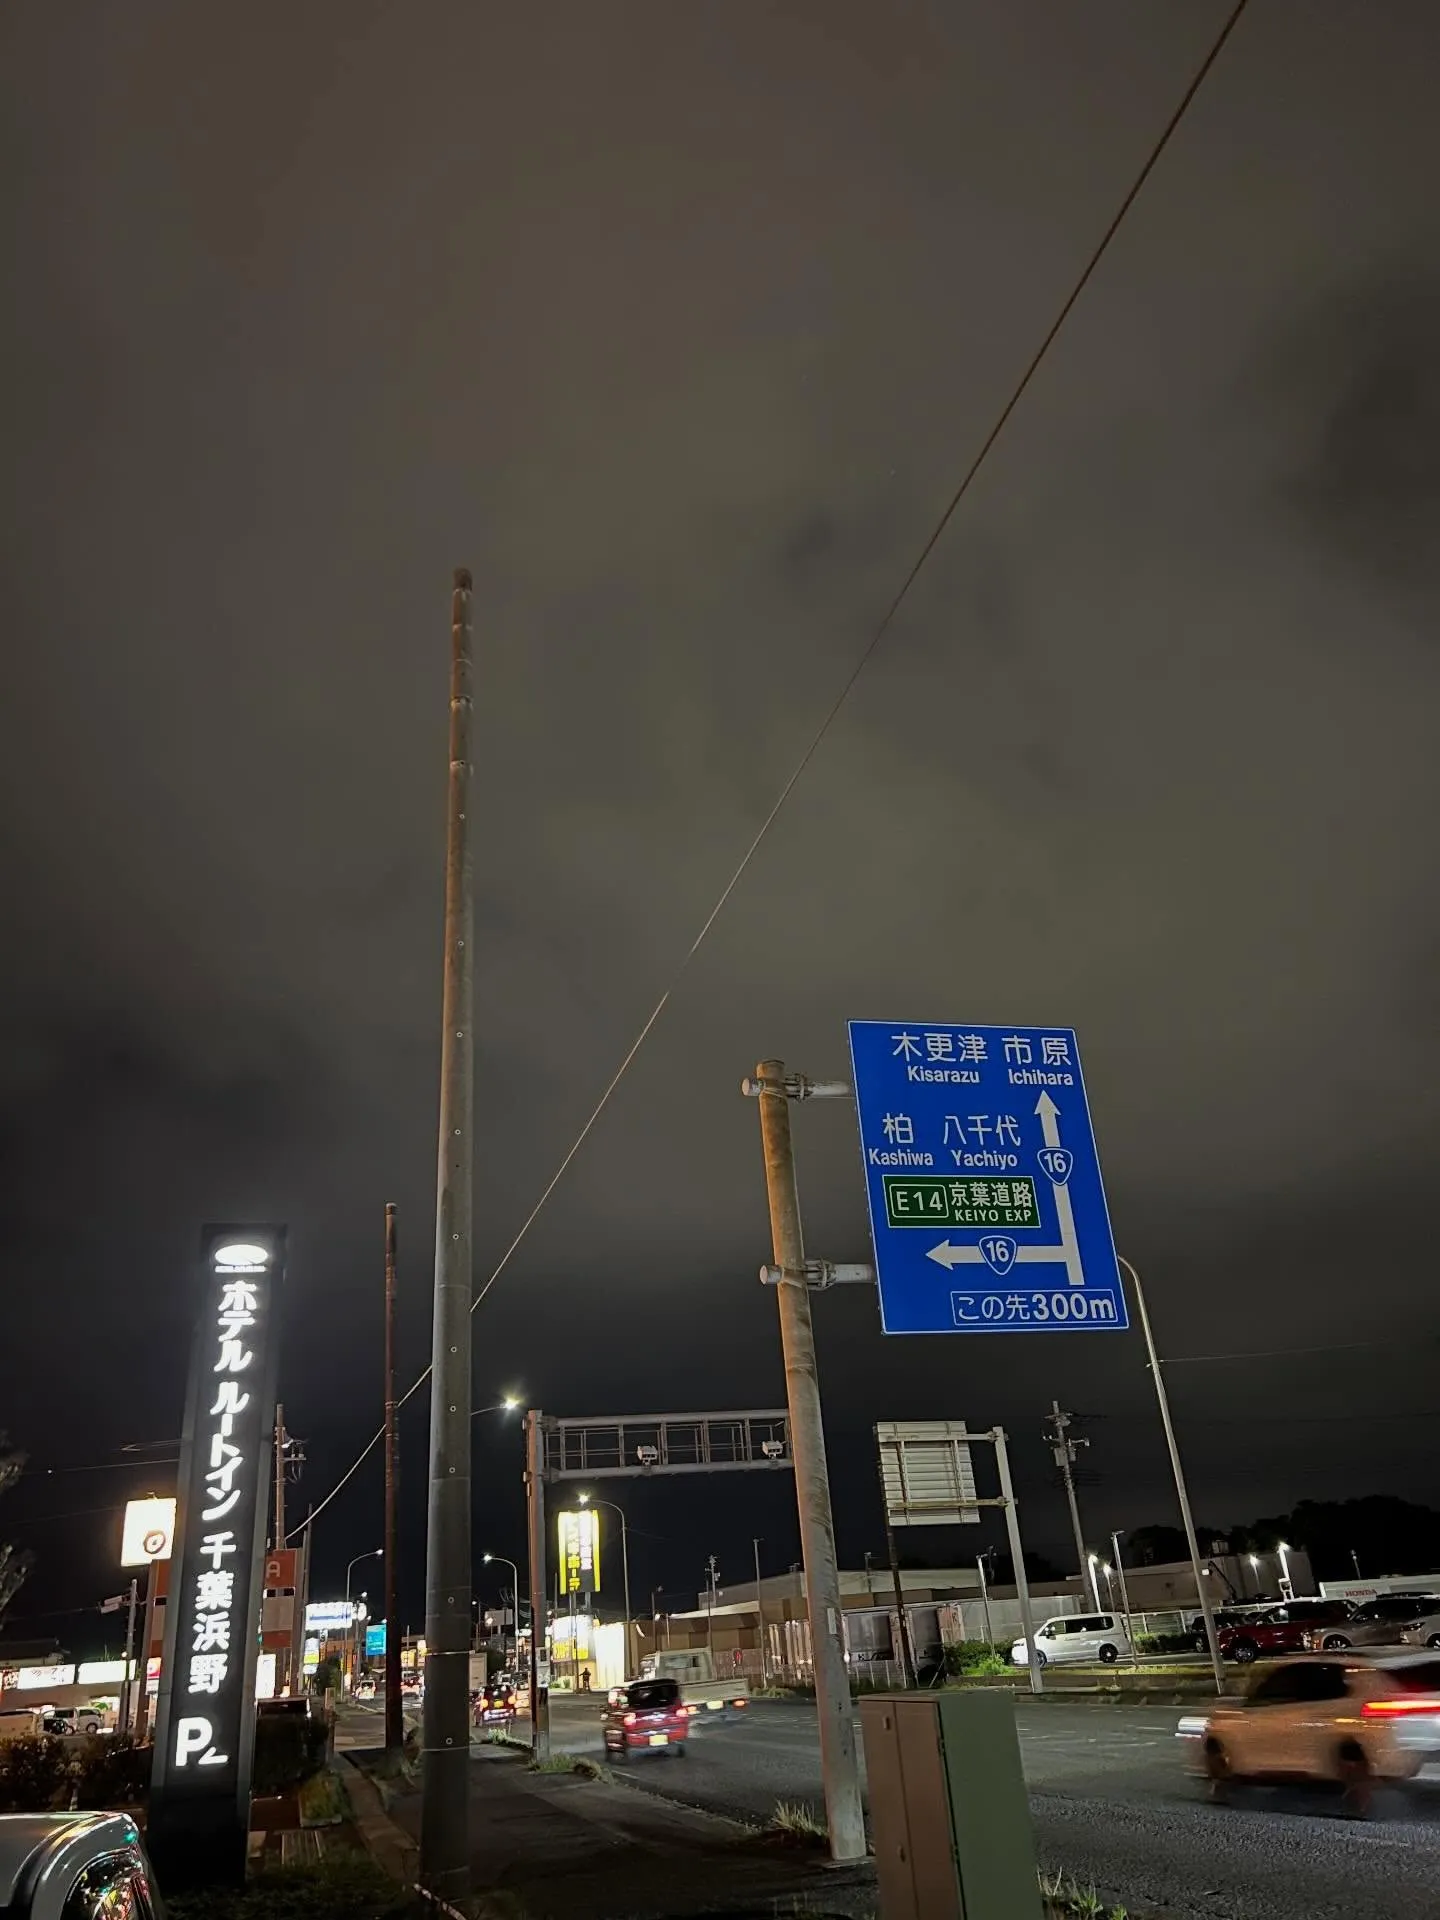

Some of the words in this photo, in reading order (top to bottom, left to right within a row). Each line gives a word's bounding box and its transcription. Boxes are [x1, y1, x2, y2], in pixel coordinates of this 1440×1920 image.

[892, 1032, 987, 1063] 木更津
[1002, 1035, 1071, 1065] 市原
[908, 1067, 979, 1083] Kisarazu
[1009, 1069, 1073, 1085] Ichihara
[883, 1113, 913, 1143] 柏
[944, 1115, 1020, 1146] 八千代
[870, 1149, 933, 1165] Kashiwa
[952, 1150, 1017, 1169] Yachiyo
[1043, 1153, 1066, 1173] 16
[897, 1192, 942, 1210] E14
[949, 1181, 1033, 1207] 京葉道路
[955, 1210, 998, 1221] KEIYO
[1006, 1210, 1031, 1221] EXP
[985, 1241, 1009, 1263] 16
[214, 1280, 258, 1372] ホテル
[202, 1382, 249, 1520] ルートイン
[188, 1531, 236, 1693] 千葉浜野
[176, 1717, 213, 1766] P
